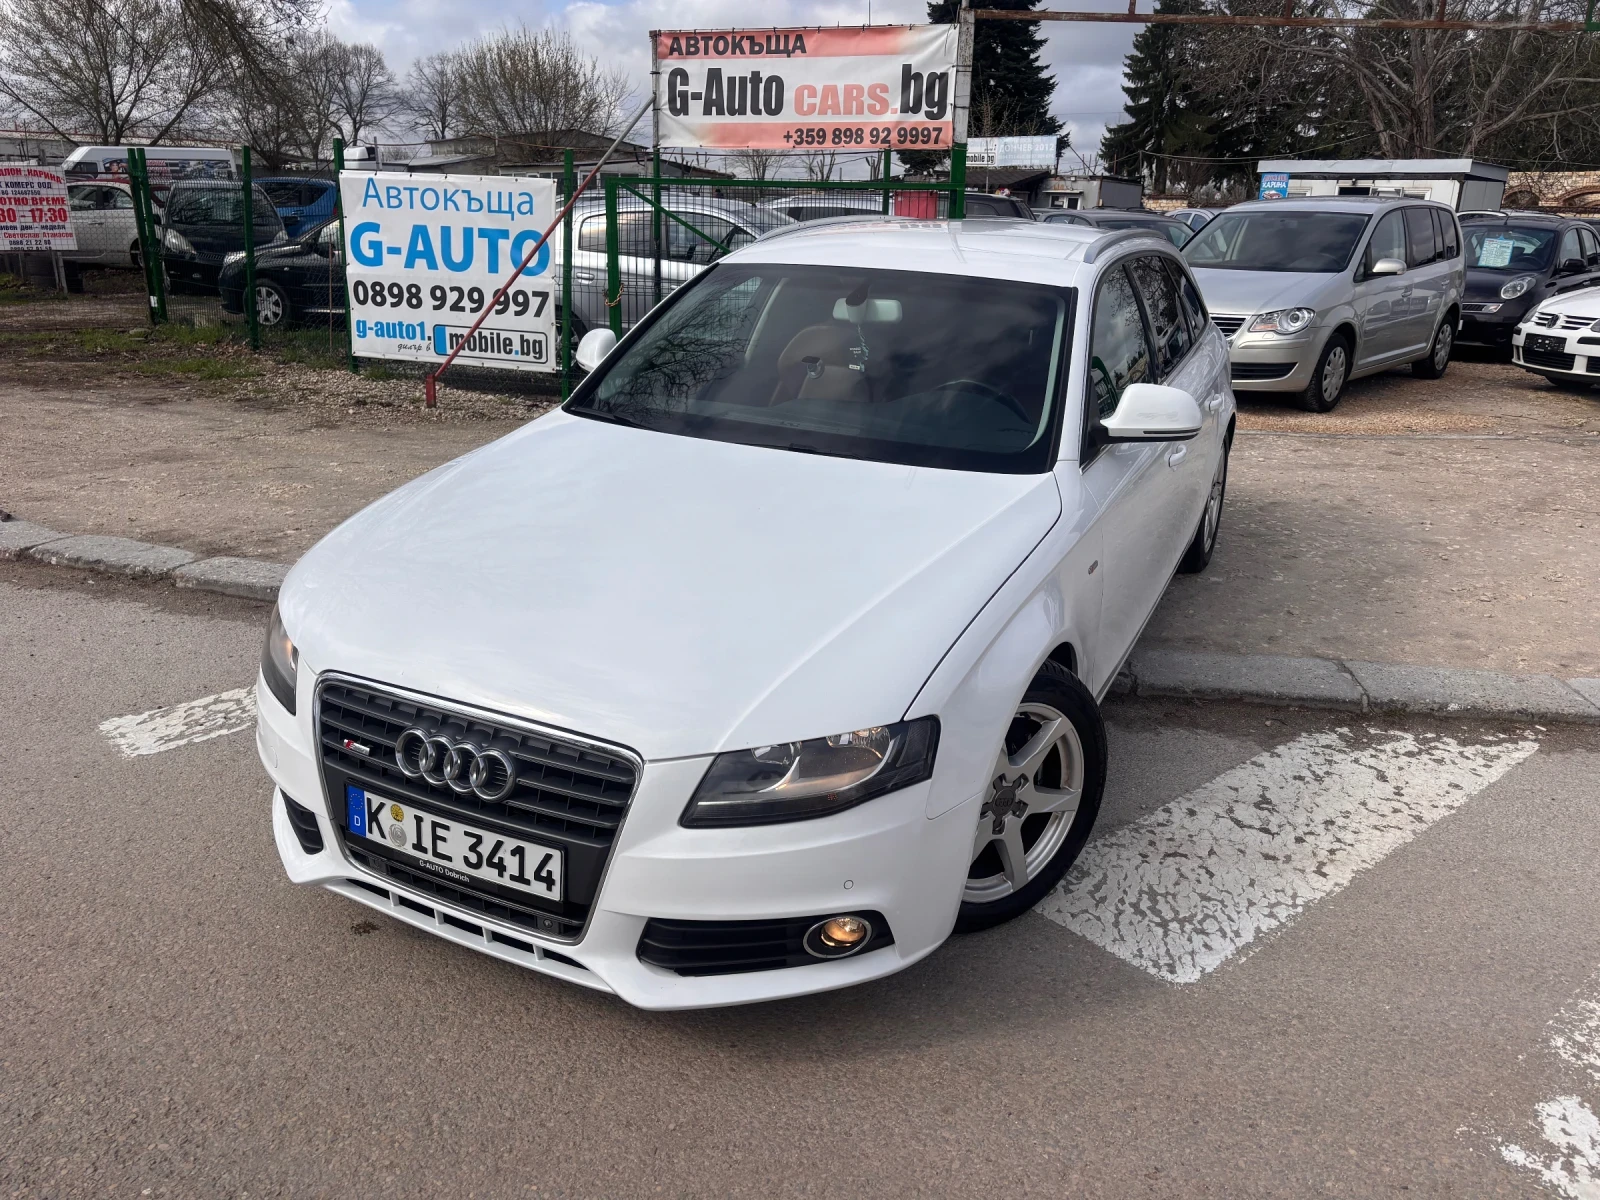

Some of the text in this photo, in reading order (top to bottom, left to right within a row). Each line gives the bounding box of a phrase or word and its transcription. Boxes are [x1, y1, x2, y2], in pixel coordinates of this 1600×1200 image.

[669, 34, 807, 58] АВТОКЪЩА
[668, 67, 785, 116] G-Auto
[783, 127, 943, 146] +359 898 92 9997
[1035, 143, 1055, 151] 2012
[31, 196, 67, 206] ВРЕМЕ
[362, 177, 534, 221] Автокъща
[28, 207, 68, 223] 17:30
[350, 221, 550, 277] G-AUTO
[353, 280, 550, 318] 0898 929 997
[449, 331, 543, 360] mobile.bg
[354, 815, 361, 827] D
[366, 797, 556, 893] K IE 3414
[444, 868, 470, 883] Dobrich
